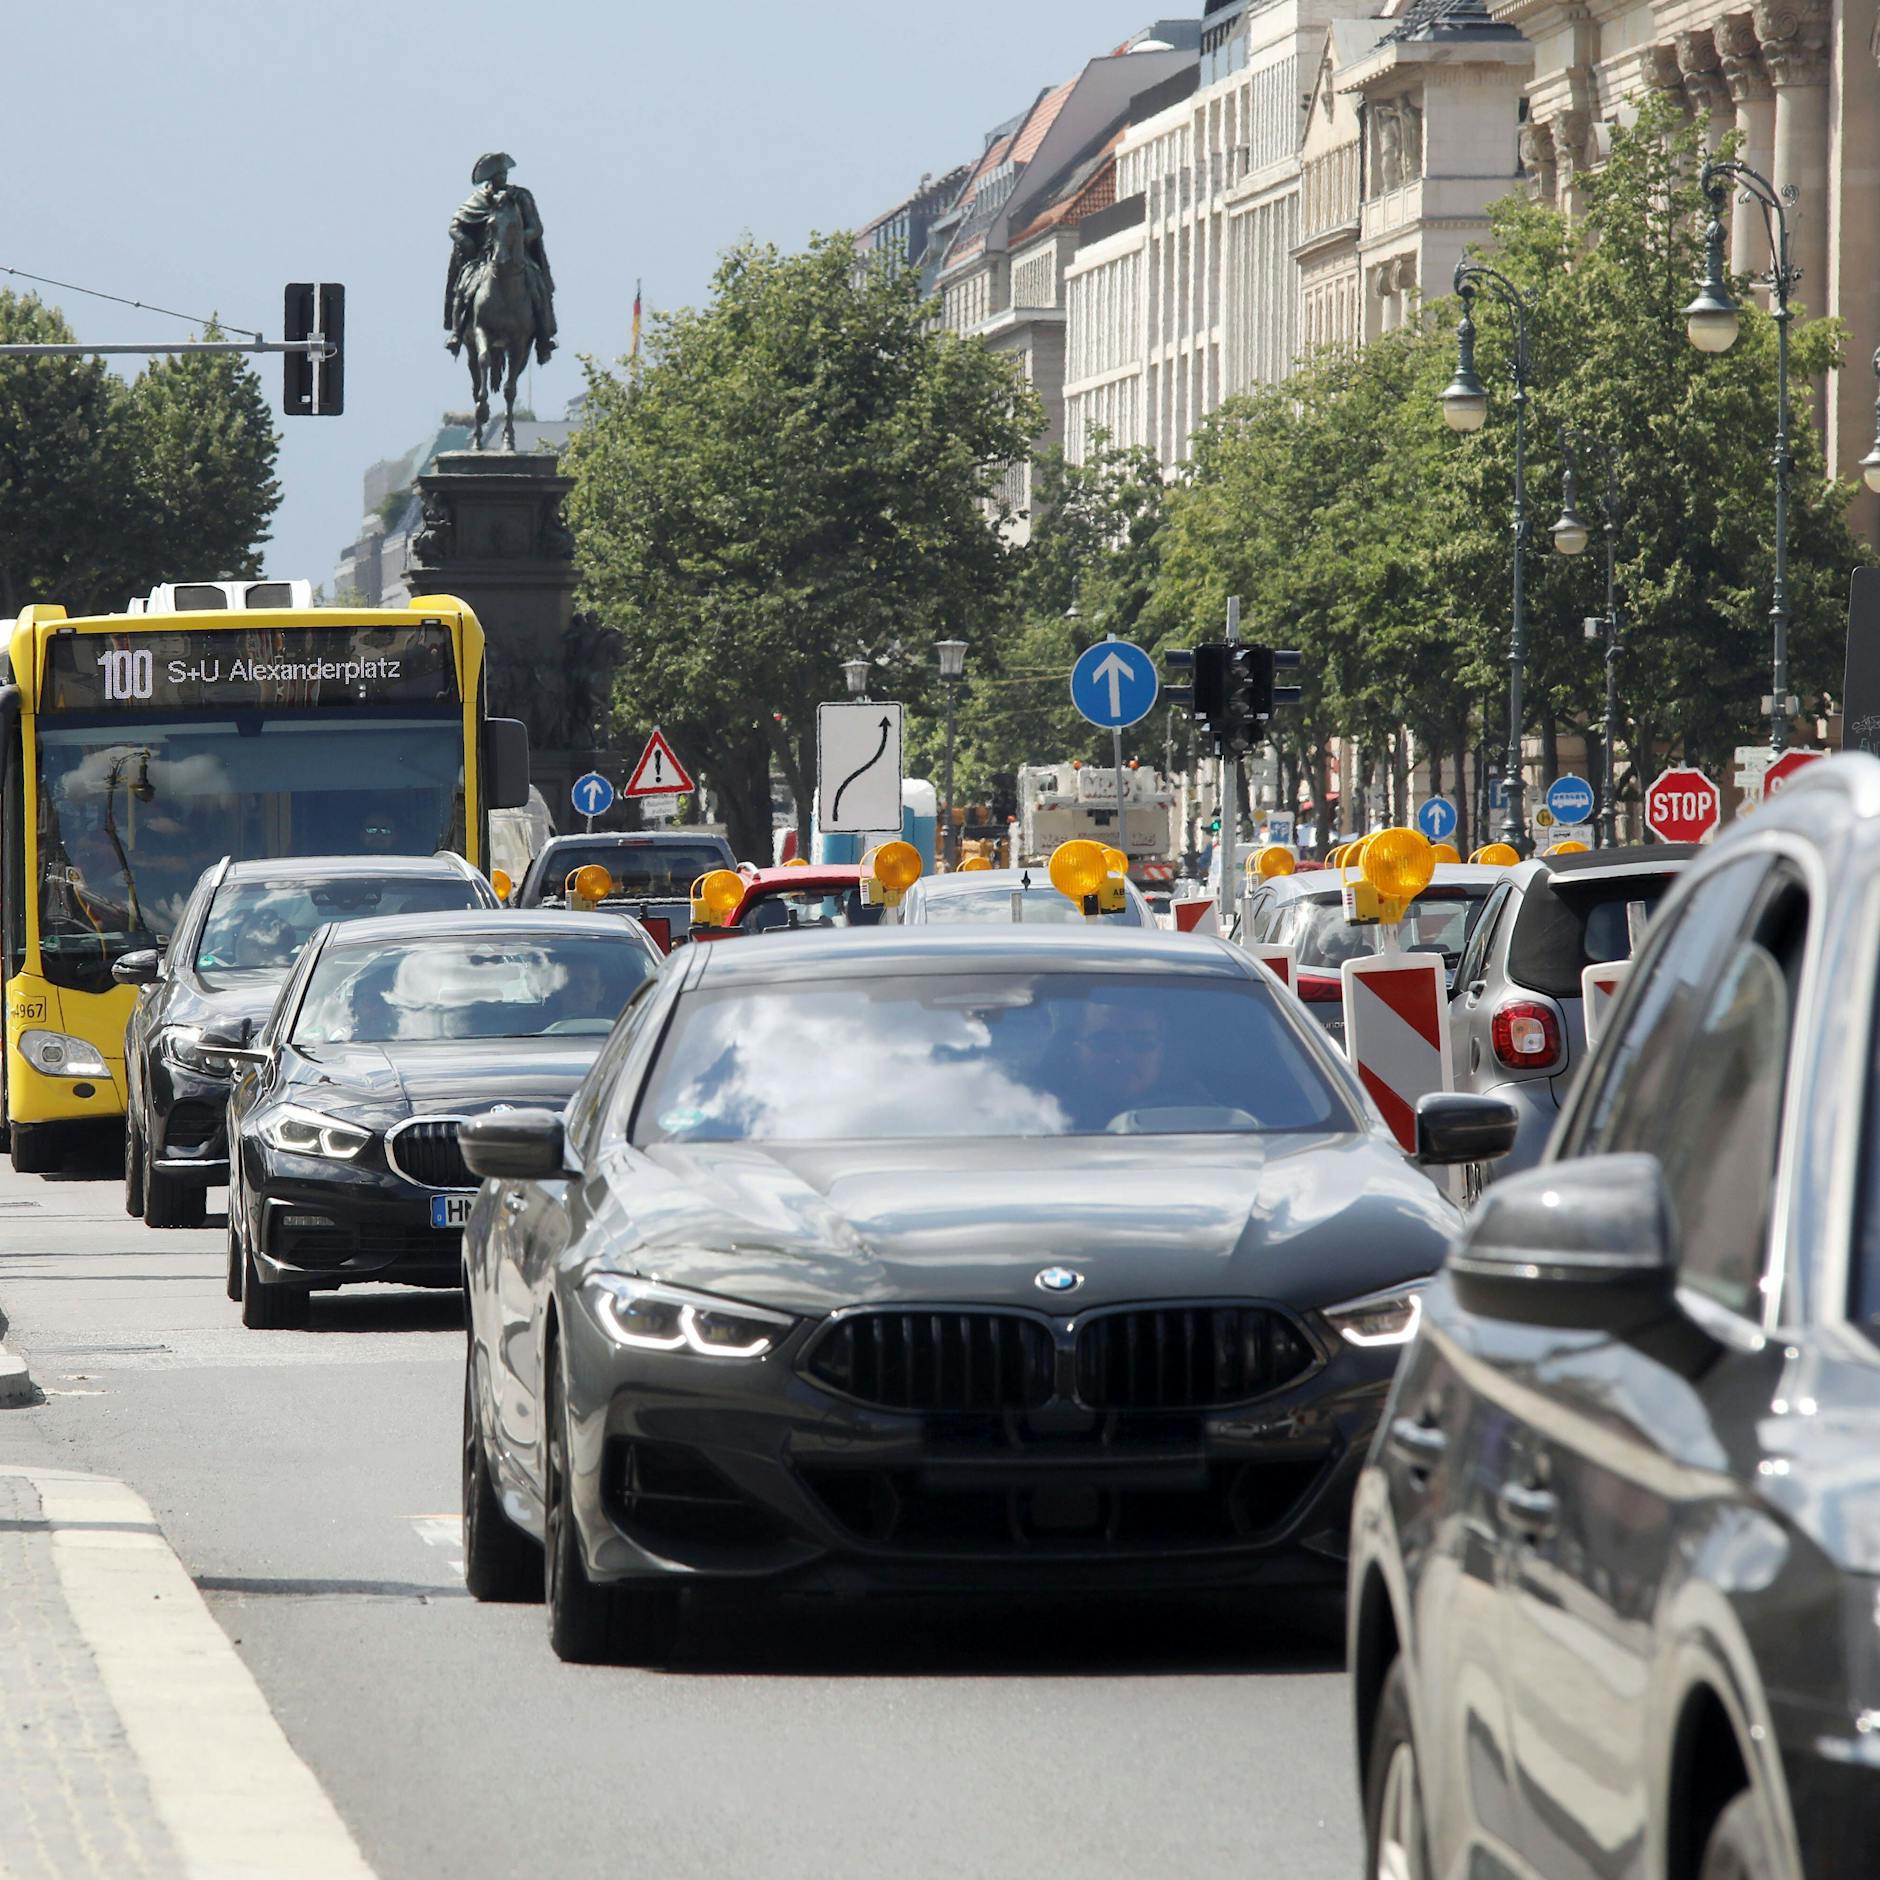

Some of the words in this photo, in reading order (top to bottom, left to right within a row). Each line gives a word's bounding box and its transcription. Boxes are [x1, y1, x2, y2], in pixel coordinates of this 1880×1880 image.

[97, 649, 153, 700] 100
[168, 659, 219, 683] S+U
[228, 656, 401, 685] Alexanderplatz
[1653, 791, 1712, 822] STOP
[15, 1003, 43, 1018] 4967
